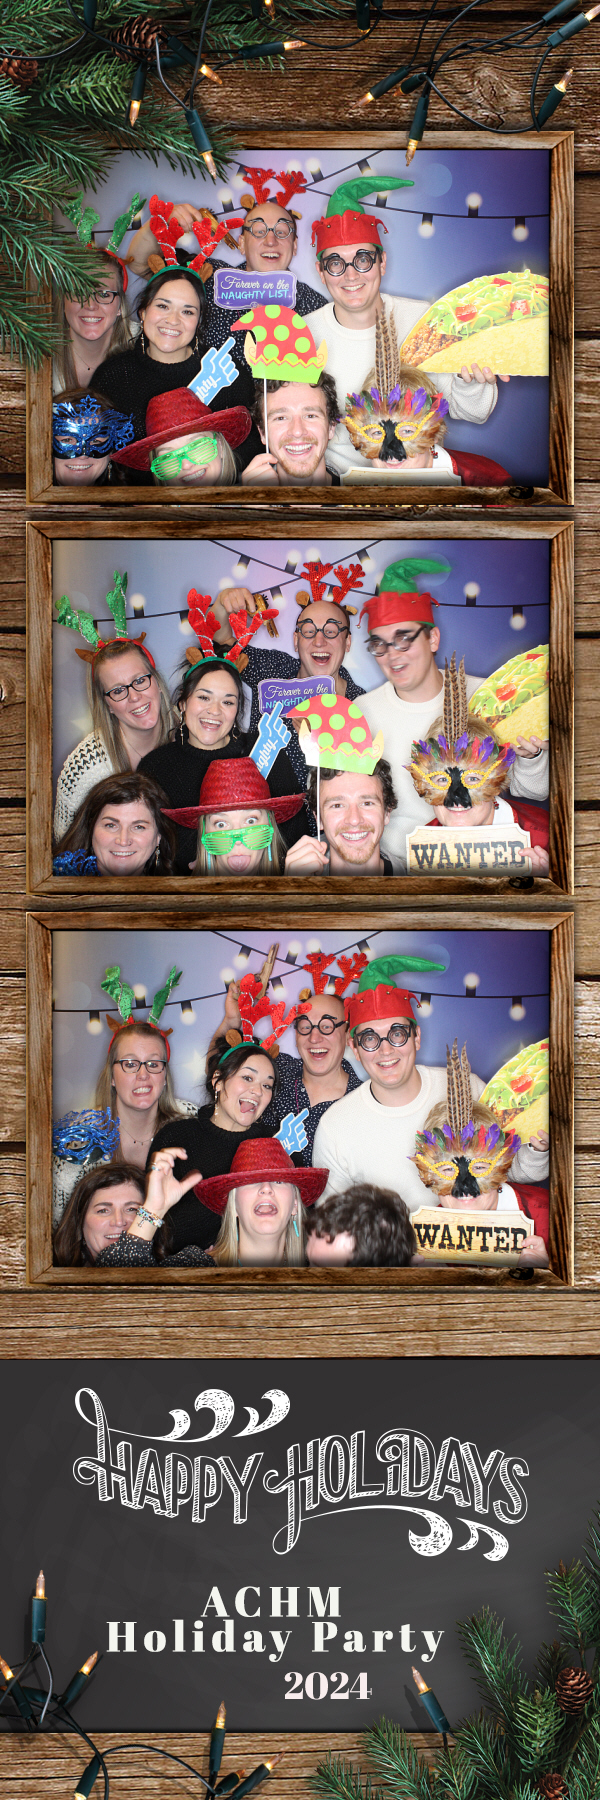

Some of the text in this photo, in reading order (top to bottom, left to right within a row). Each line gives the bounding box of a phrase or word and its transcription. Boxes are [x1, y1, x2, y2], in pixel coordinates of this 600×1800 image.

[221, 275, 261, 290] Forever
[277, 279, 290, 290] the
[221, 289, 290, 300] NAUGHTY LIST
[264, 685, 301, 699] Forever
[316, 683, 329, 694] the
[411, 841, 526, 869] WANTED
[414, 1223, 527, 1254] WANTED
